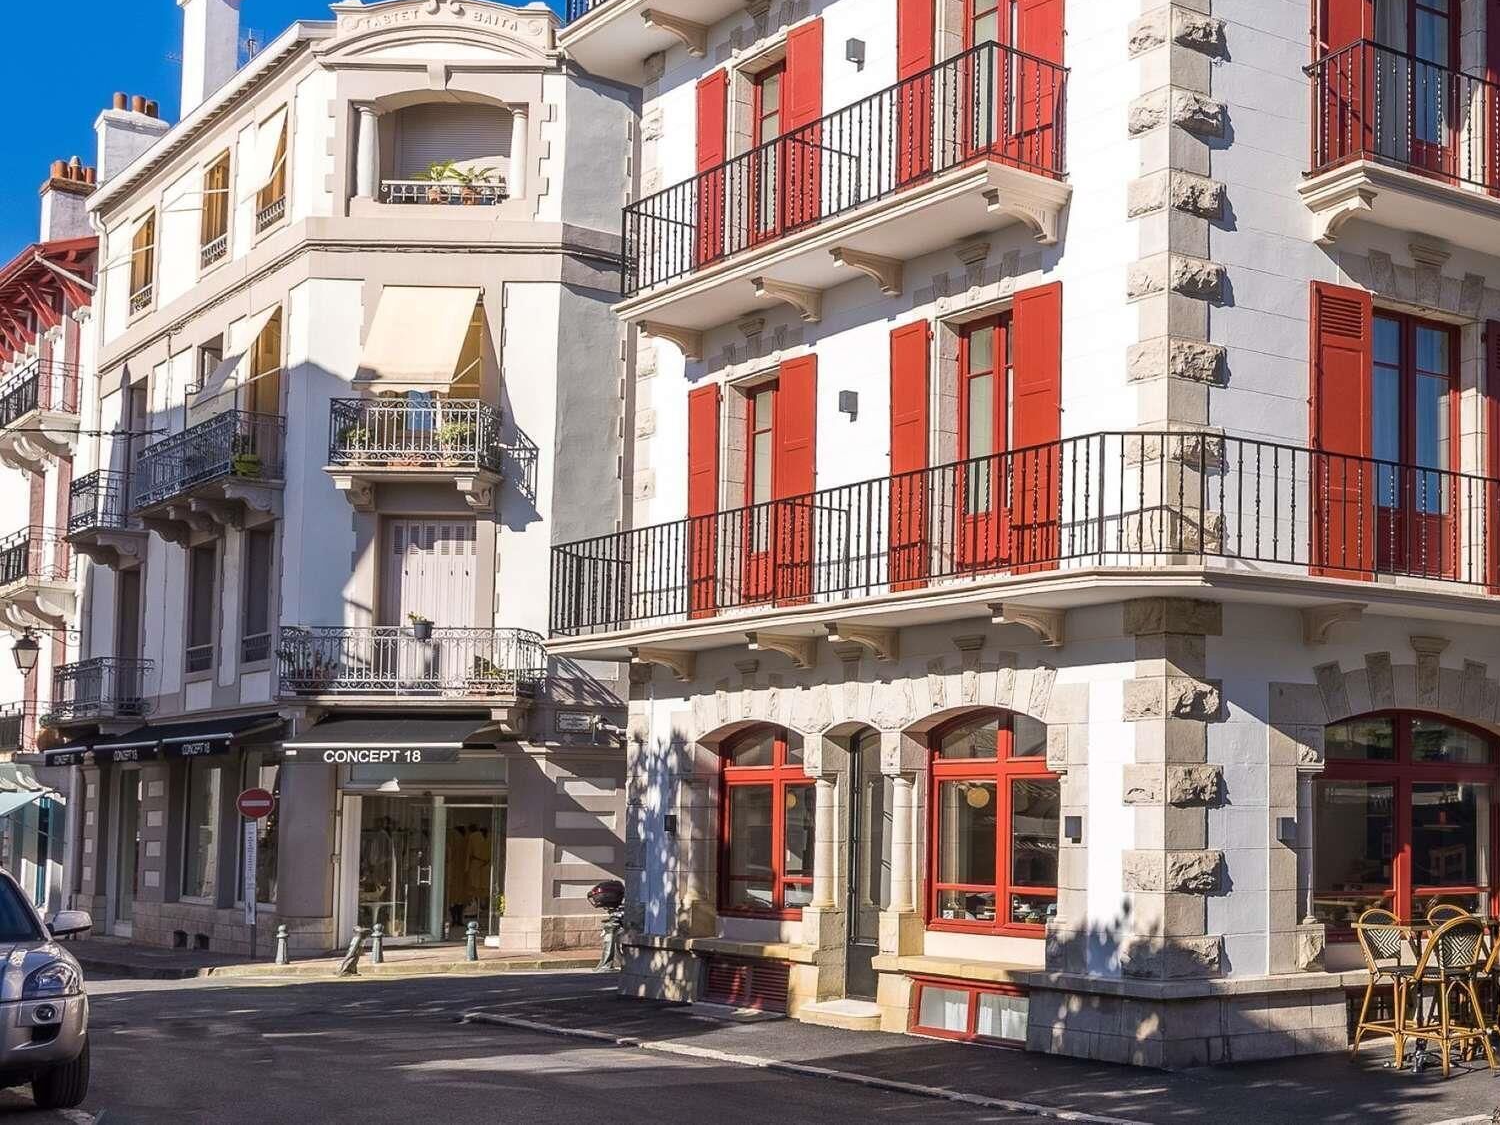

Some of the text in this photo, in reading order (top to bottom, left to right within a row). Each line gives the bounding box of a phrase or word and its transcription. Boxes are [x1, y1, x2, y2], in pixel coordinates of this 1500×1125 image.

[472, 11, 519, 32] BAITA
[323, 750, 421, 763] CONCEPT 18
